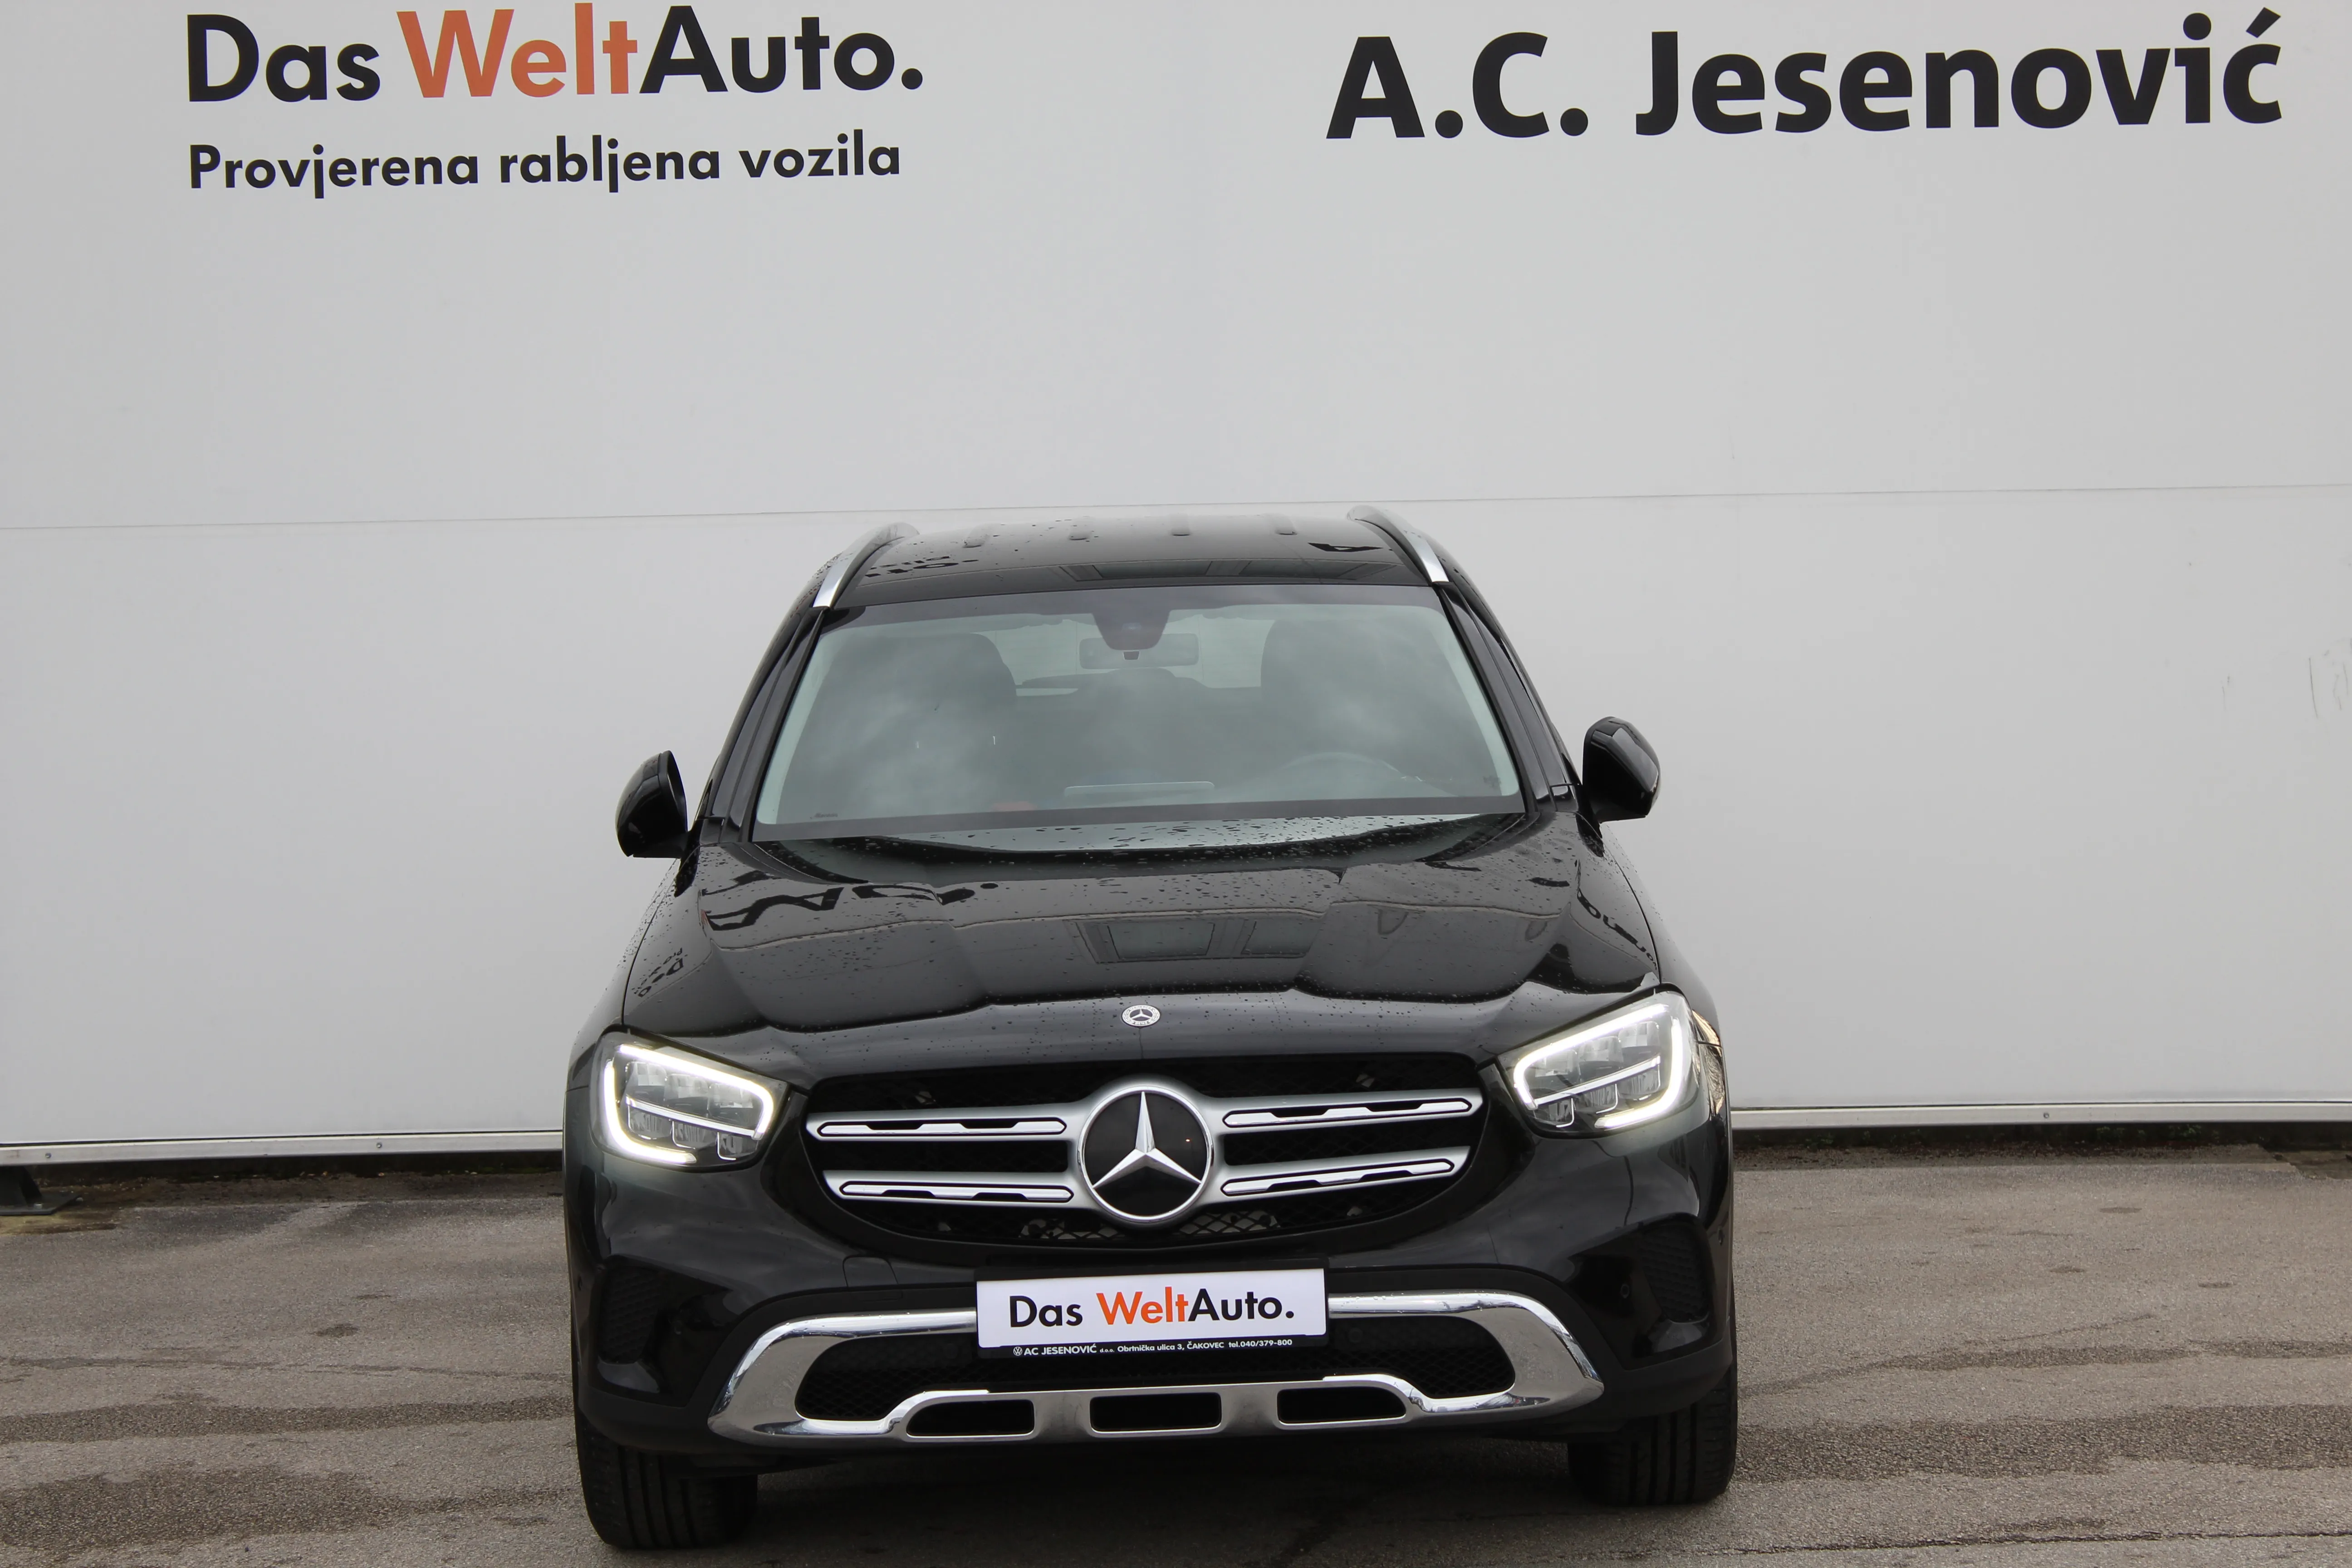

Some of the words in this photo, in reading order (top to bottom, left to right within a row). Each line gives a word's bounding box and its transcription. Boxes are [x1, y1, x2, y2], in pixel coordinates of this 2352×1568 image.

[187, 14, 380, 103] Das
[397, 3, 922, 98] WeltAuto.
[1326, 31, 1588, 139] A.C.
[1636, 7, 2282, 135] Jesenović
[190, 144, 478, 199] Provjerena
[500, 135, 719, 192] rabljena
[739, 129, 899, 177] vozila
[1010, 1296, 1083, 1327] Das
[1097, 1287, 1294, 1325] WeltAuto.
[1041, 1343, 1097, 1355] JESENOVIĆ
[1187, 1341, 1224, 1349] ČAKOVEC
